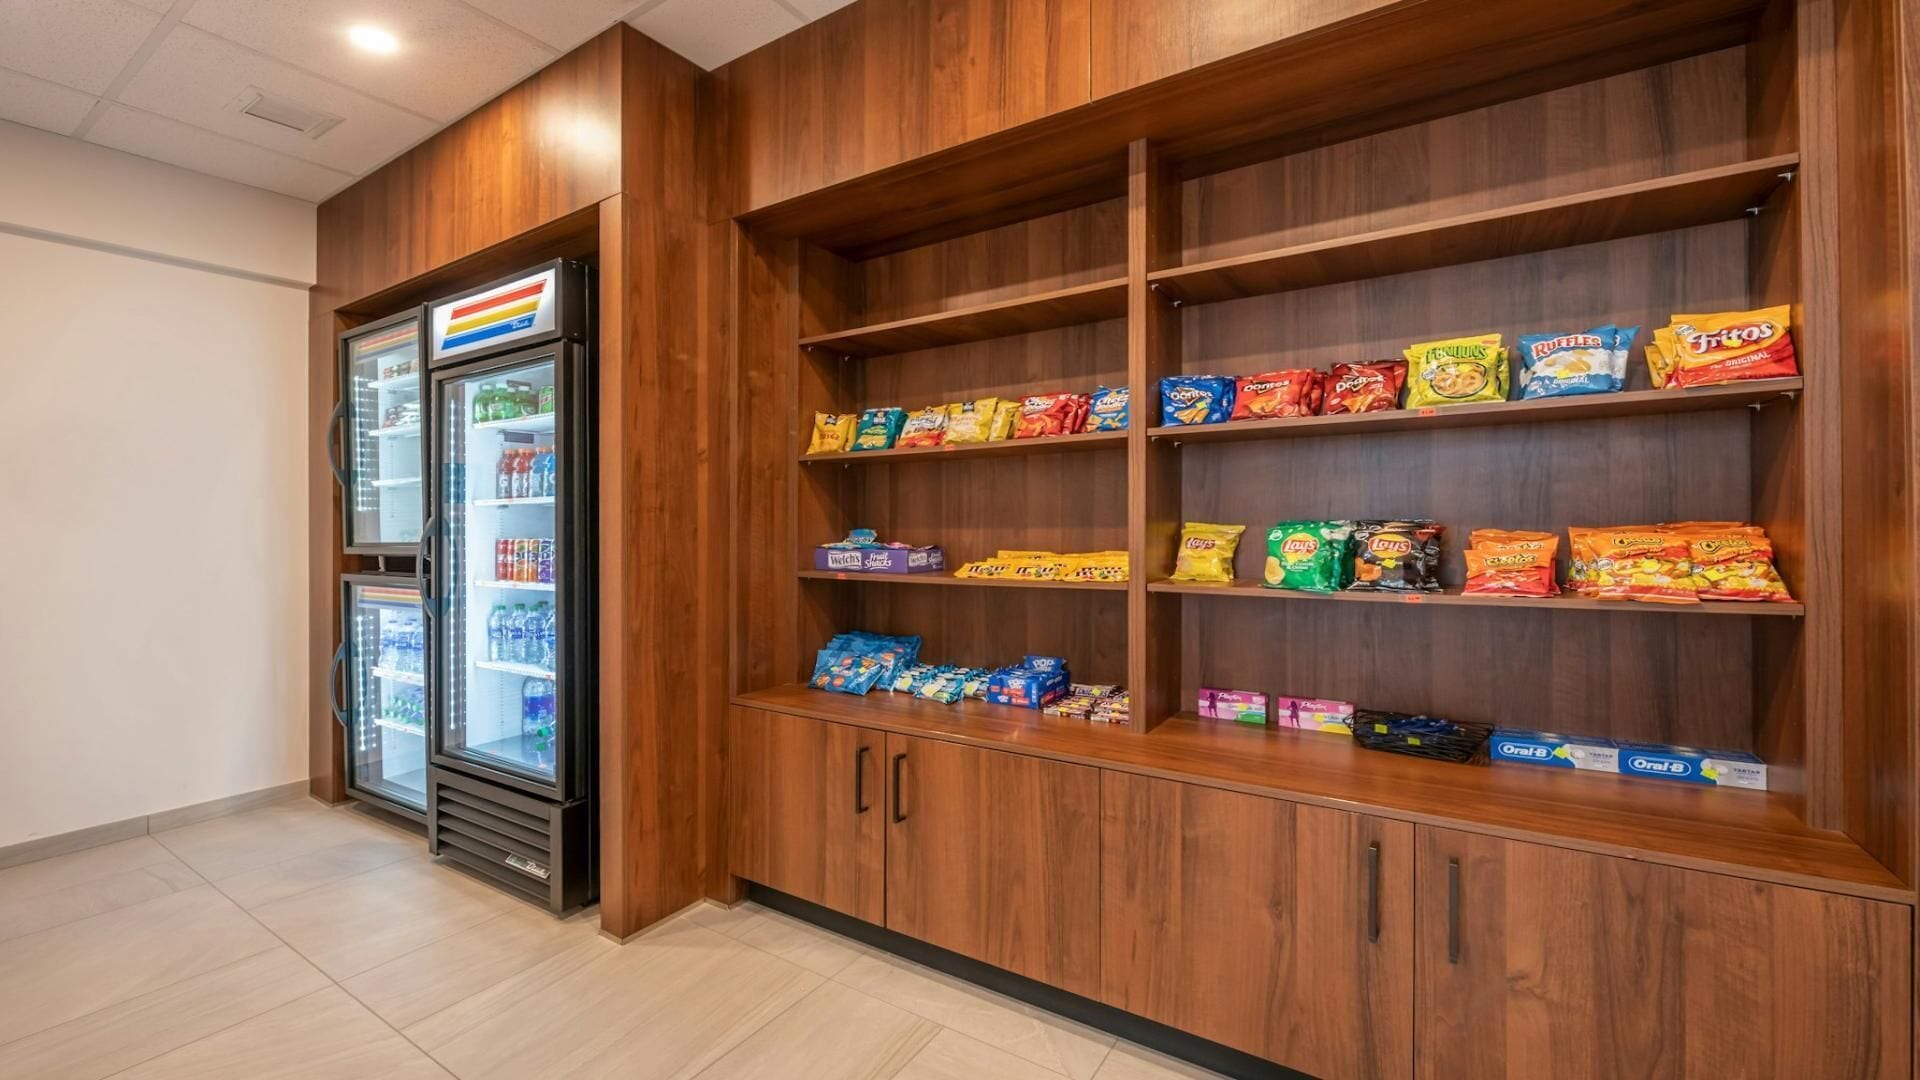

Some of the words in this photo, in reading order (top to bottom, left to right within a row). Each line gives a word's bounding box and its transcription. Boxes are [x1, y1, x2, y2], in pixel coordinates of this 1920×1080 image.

[1687, 323, 1773, 354] Fritos
[1533, 334, 1602, 358] RUFFLES
[1725, 351, 1771, 367] ORIGINAL
[1244, 380, 1291, 392] Doritos
[1170, 390, 1213, 401] Doritos
[831, 552, 861, 566] Welch's
[870, 552, 888, 561] Fruit
[1503, 745, 1548, 757] Oral-B
[1633, 759, 1685, 773] Oral-B
